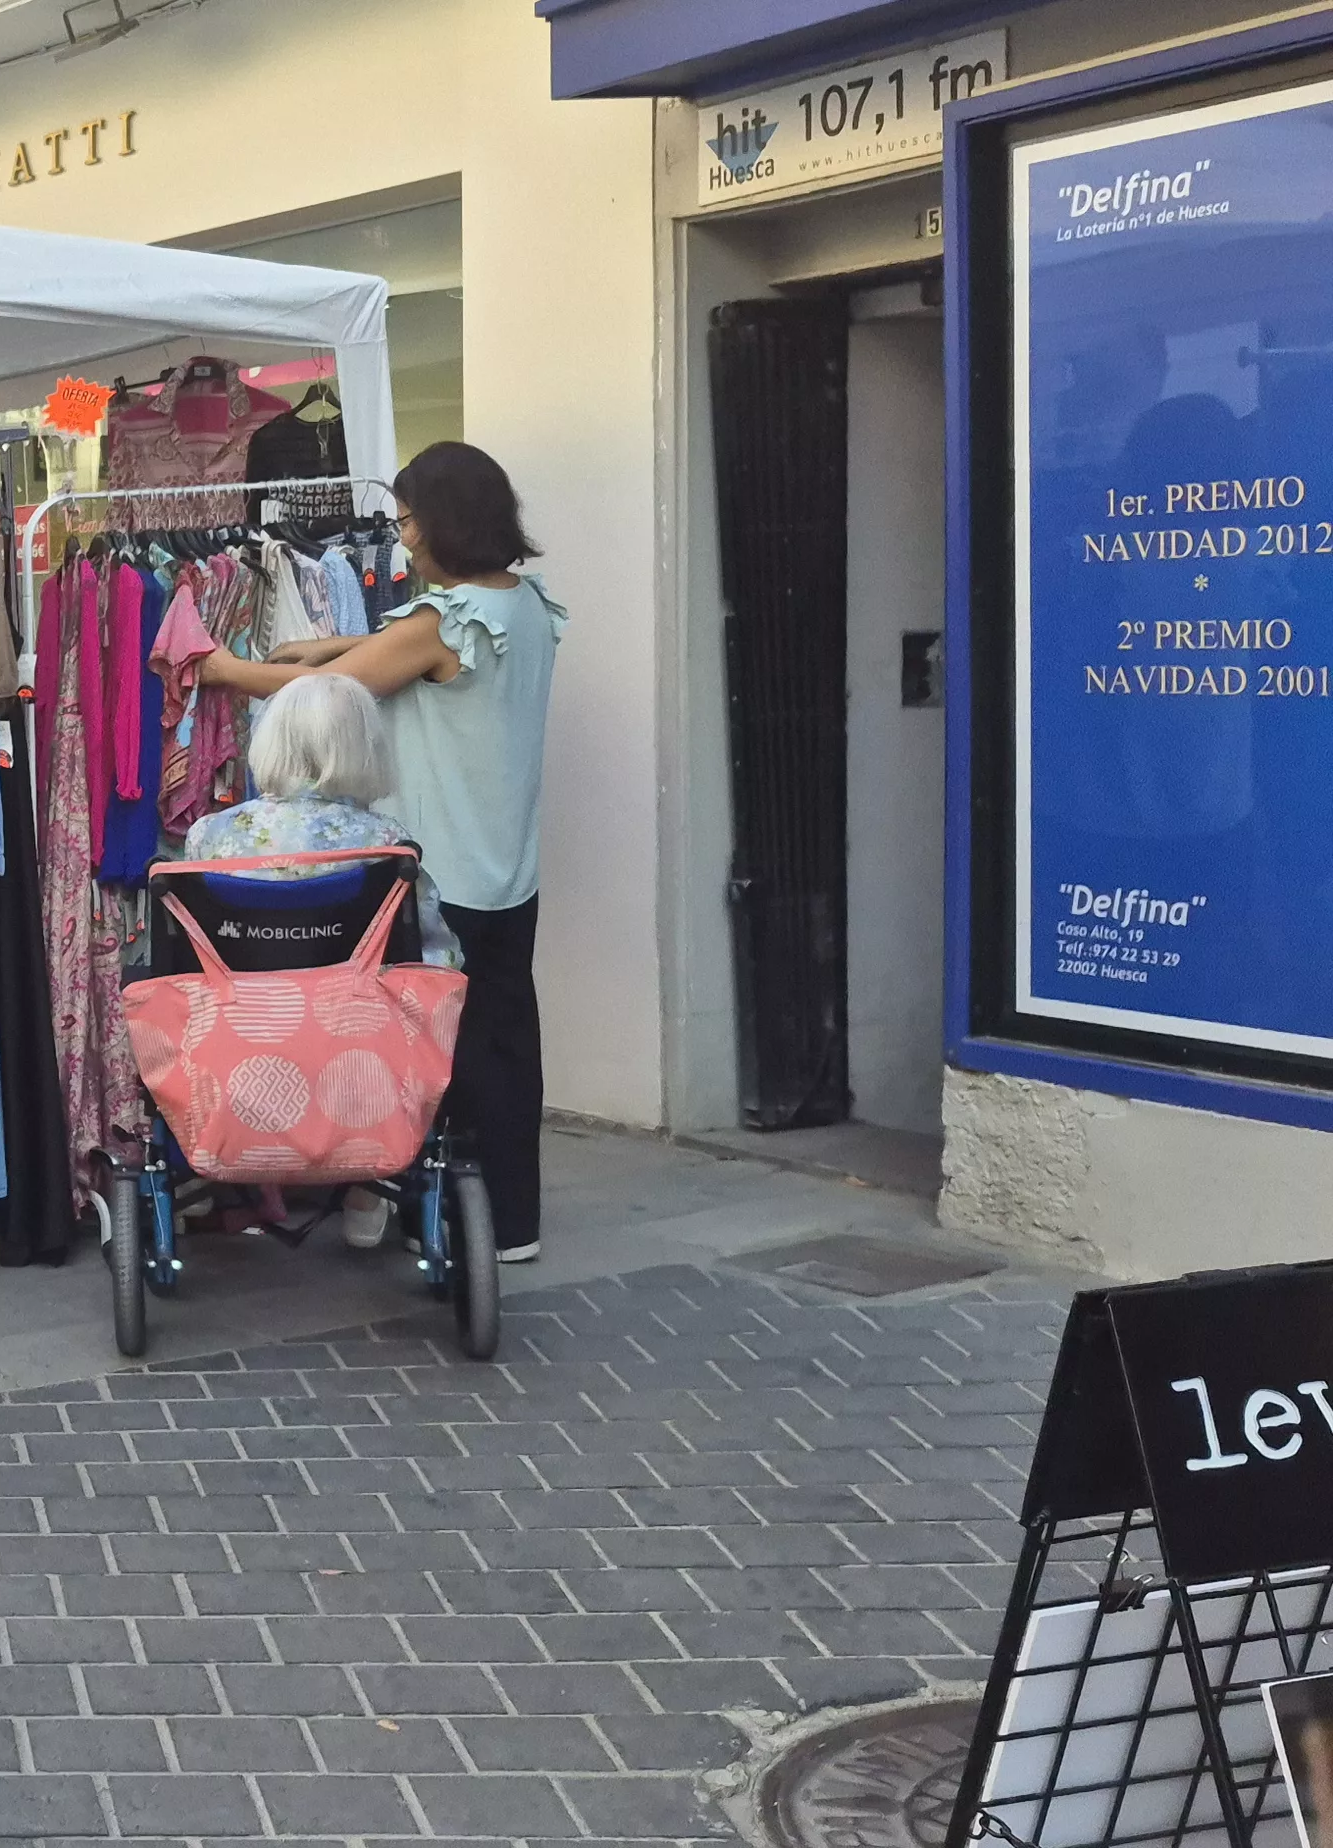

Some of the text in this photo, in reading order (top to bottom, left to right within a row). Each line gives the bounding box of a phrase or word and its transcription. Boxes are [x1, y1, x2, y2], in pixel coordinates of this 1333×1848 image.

[798, 55, 993, 143] 107,1 fm
[716, 107, 767, 161] hit
[709, 157, 775, 190] Huesca
[1059, 159, 1211, 218] "Delfina"
[1056, 226, 1072, 242] La
[1156, 208, 1173, 225] de
[1178, 200, 1230, 221] Huesca
[62, 387, 101, 407] OFERTA
[1106, 475, 1306, 518] 1er. PREMIO
[1083, 521, 1333, 563] NAVIDAD 2012
[1155, 618, 1293, 650] PREMIO
[1084, 664, 1330, 698] NAVIDAD 2001
[1059, 883, 1207, 928] "Delfina"
[246, 922, 343, 940] MOBICLINIC
[1090, 924, 1122, 944] Alto,
[1128, 928, 1145, 943] 19
[1057, 958, 1149, 983] 22002 Huesca
[1120, 947, 1138, 962] 22
[1141, 949, 1159, 965] 53
[1162, 952, 1182, 967] 29
